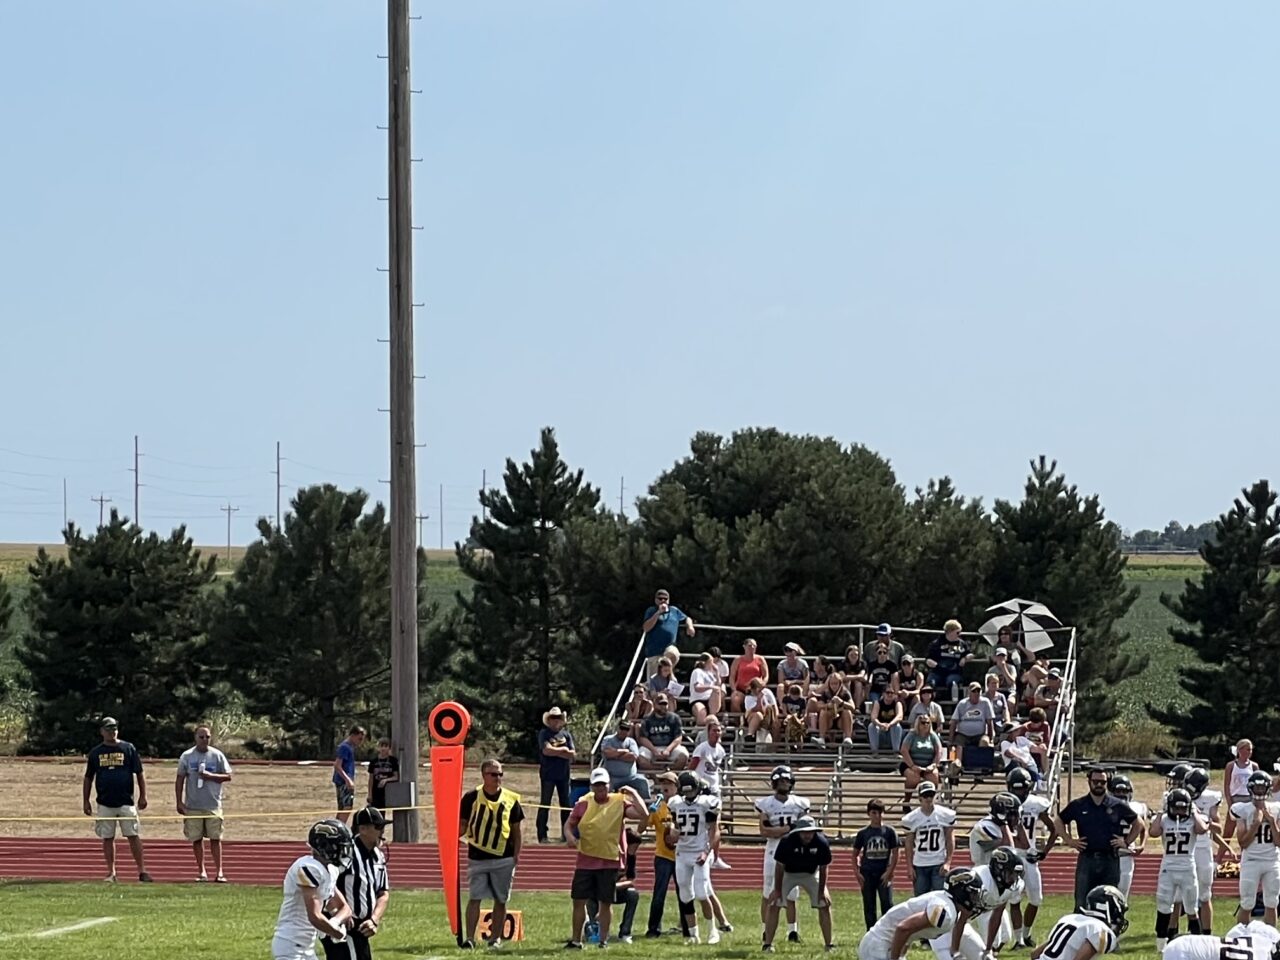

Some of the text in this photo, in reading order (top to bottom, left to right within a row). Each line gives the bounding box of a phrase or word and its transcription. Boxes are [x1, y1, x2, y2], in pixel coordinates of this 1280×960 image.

[678, 814, 699, 836] 23
[918, 829, 941, 851] 20
[1166, 832, 1191, 854] 22
